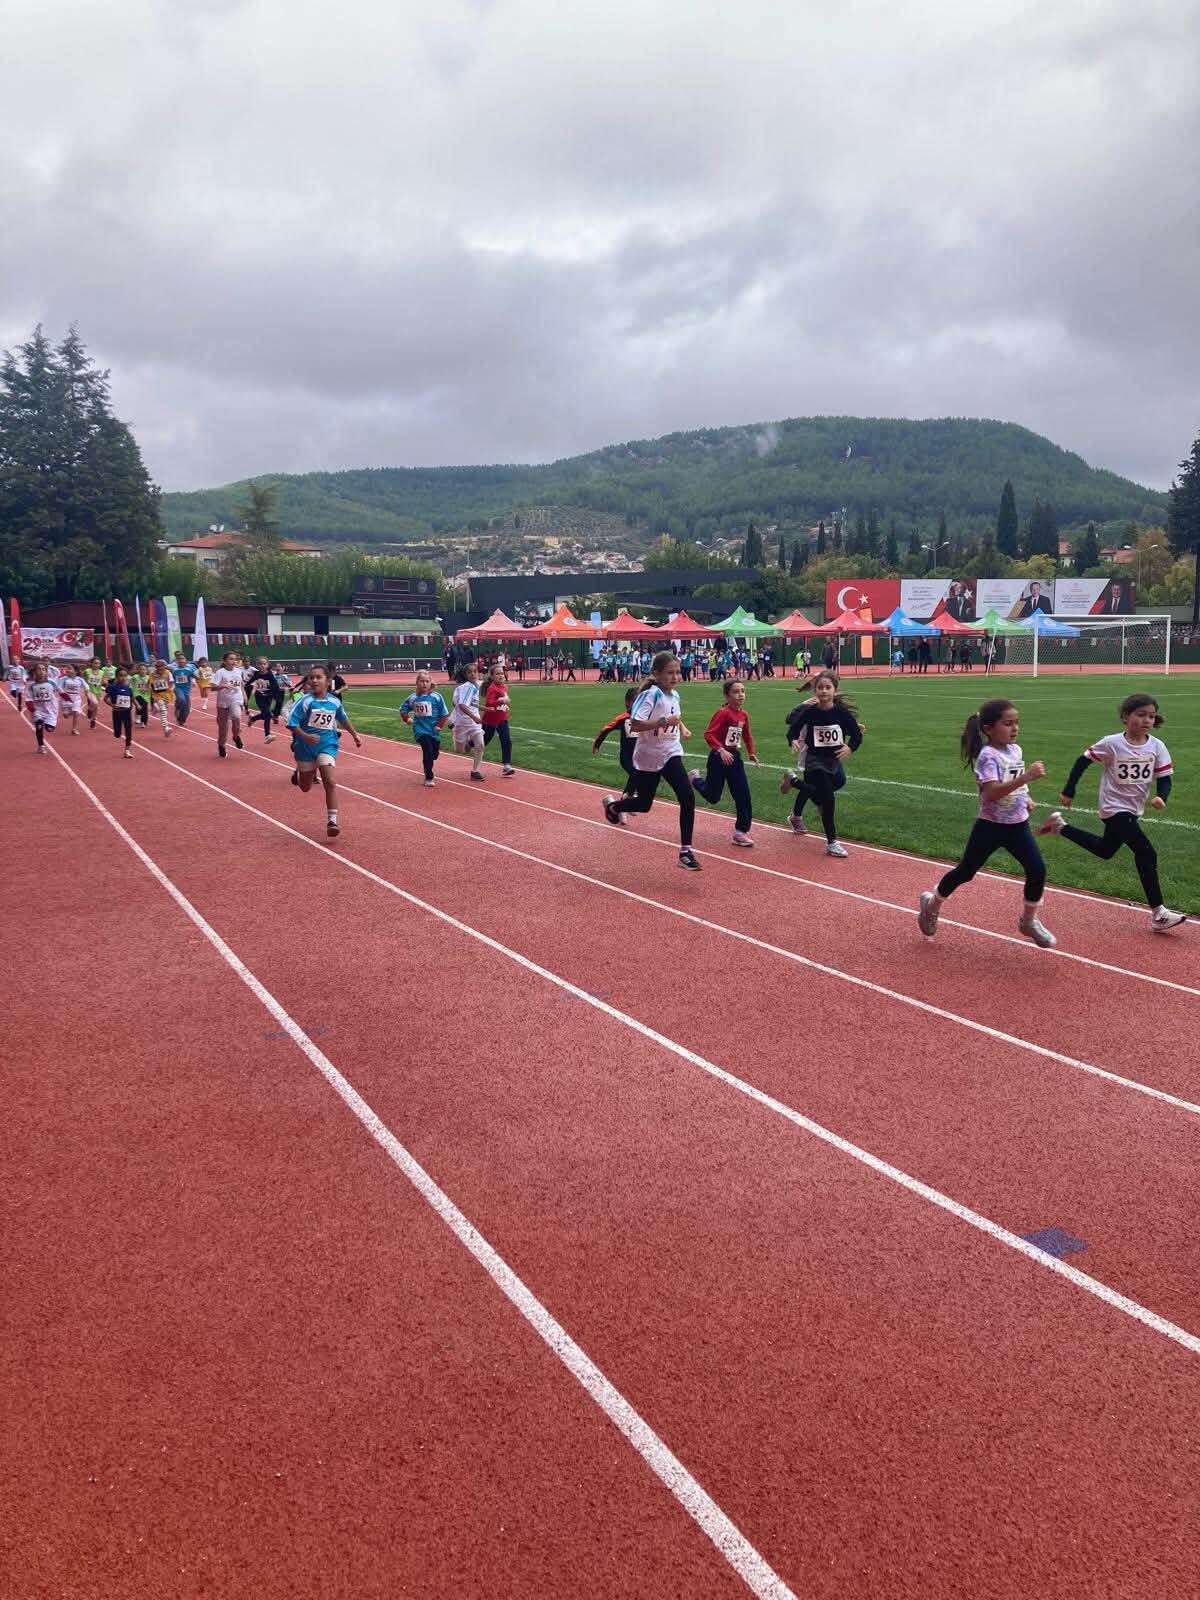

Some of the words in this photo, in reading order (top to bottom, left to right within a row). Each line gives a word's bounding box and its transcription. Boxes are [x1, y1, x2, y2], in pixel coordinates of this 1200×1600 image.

[313, 713, 332, 725] 759
[818, 729, 838, 743] 590
[1118, 763, 1151, 780] 336
